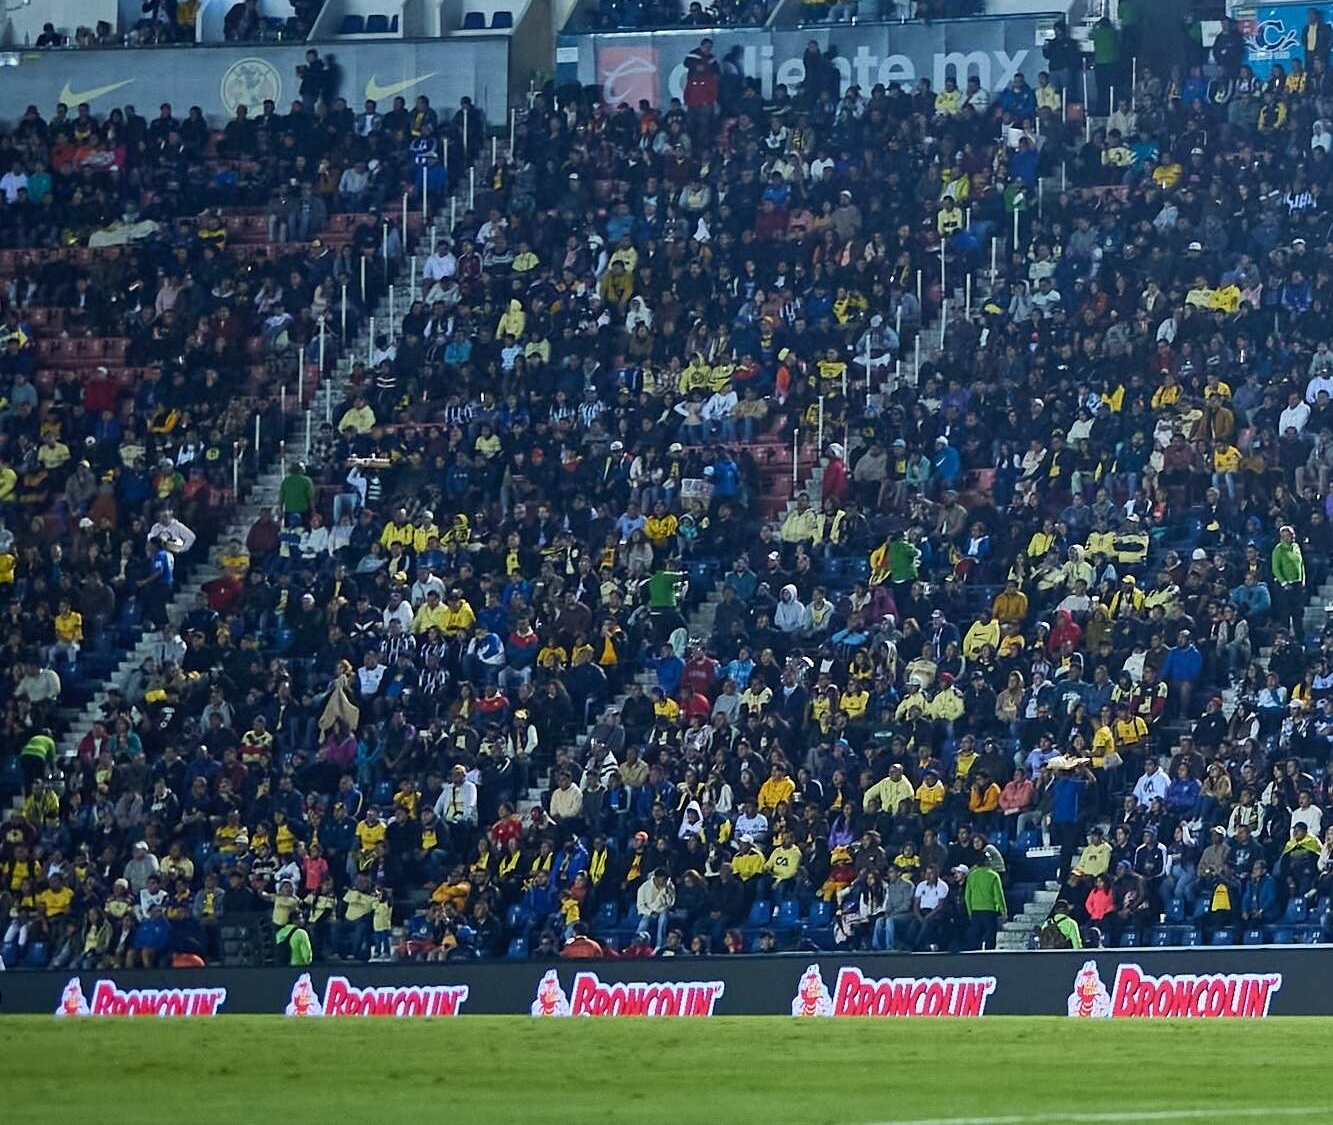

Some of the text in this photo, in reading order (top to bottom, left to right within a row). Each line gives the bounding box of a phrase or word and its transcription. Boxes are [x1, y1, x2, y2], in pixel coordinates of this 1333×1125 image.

[96, 980, 210, 1015] BRONCOLIN
[327, 978, 454, 1015] BRONCOLIN
[574, 973, 709, 1015] BRONCOLIN
[836, 967, 982, 1016] BRONCOLIN
[1113, 967, 1267, 1017] BRONCOLIN
